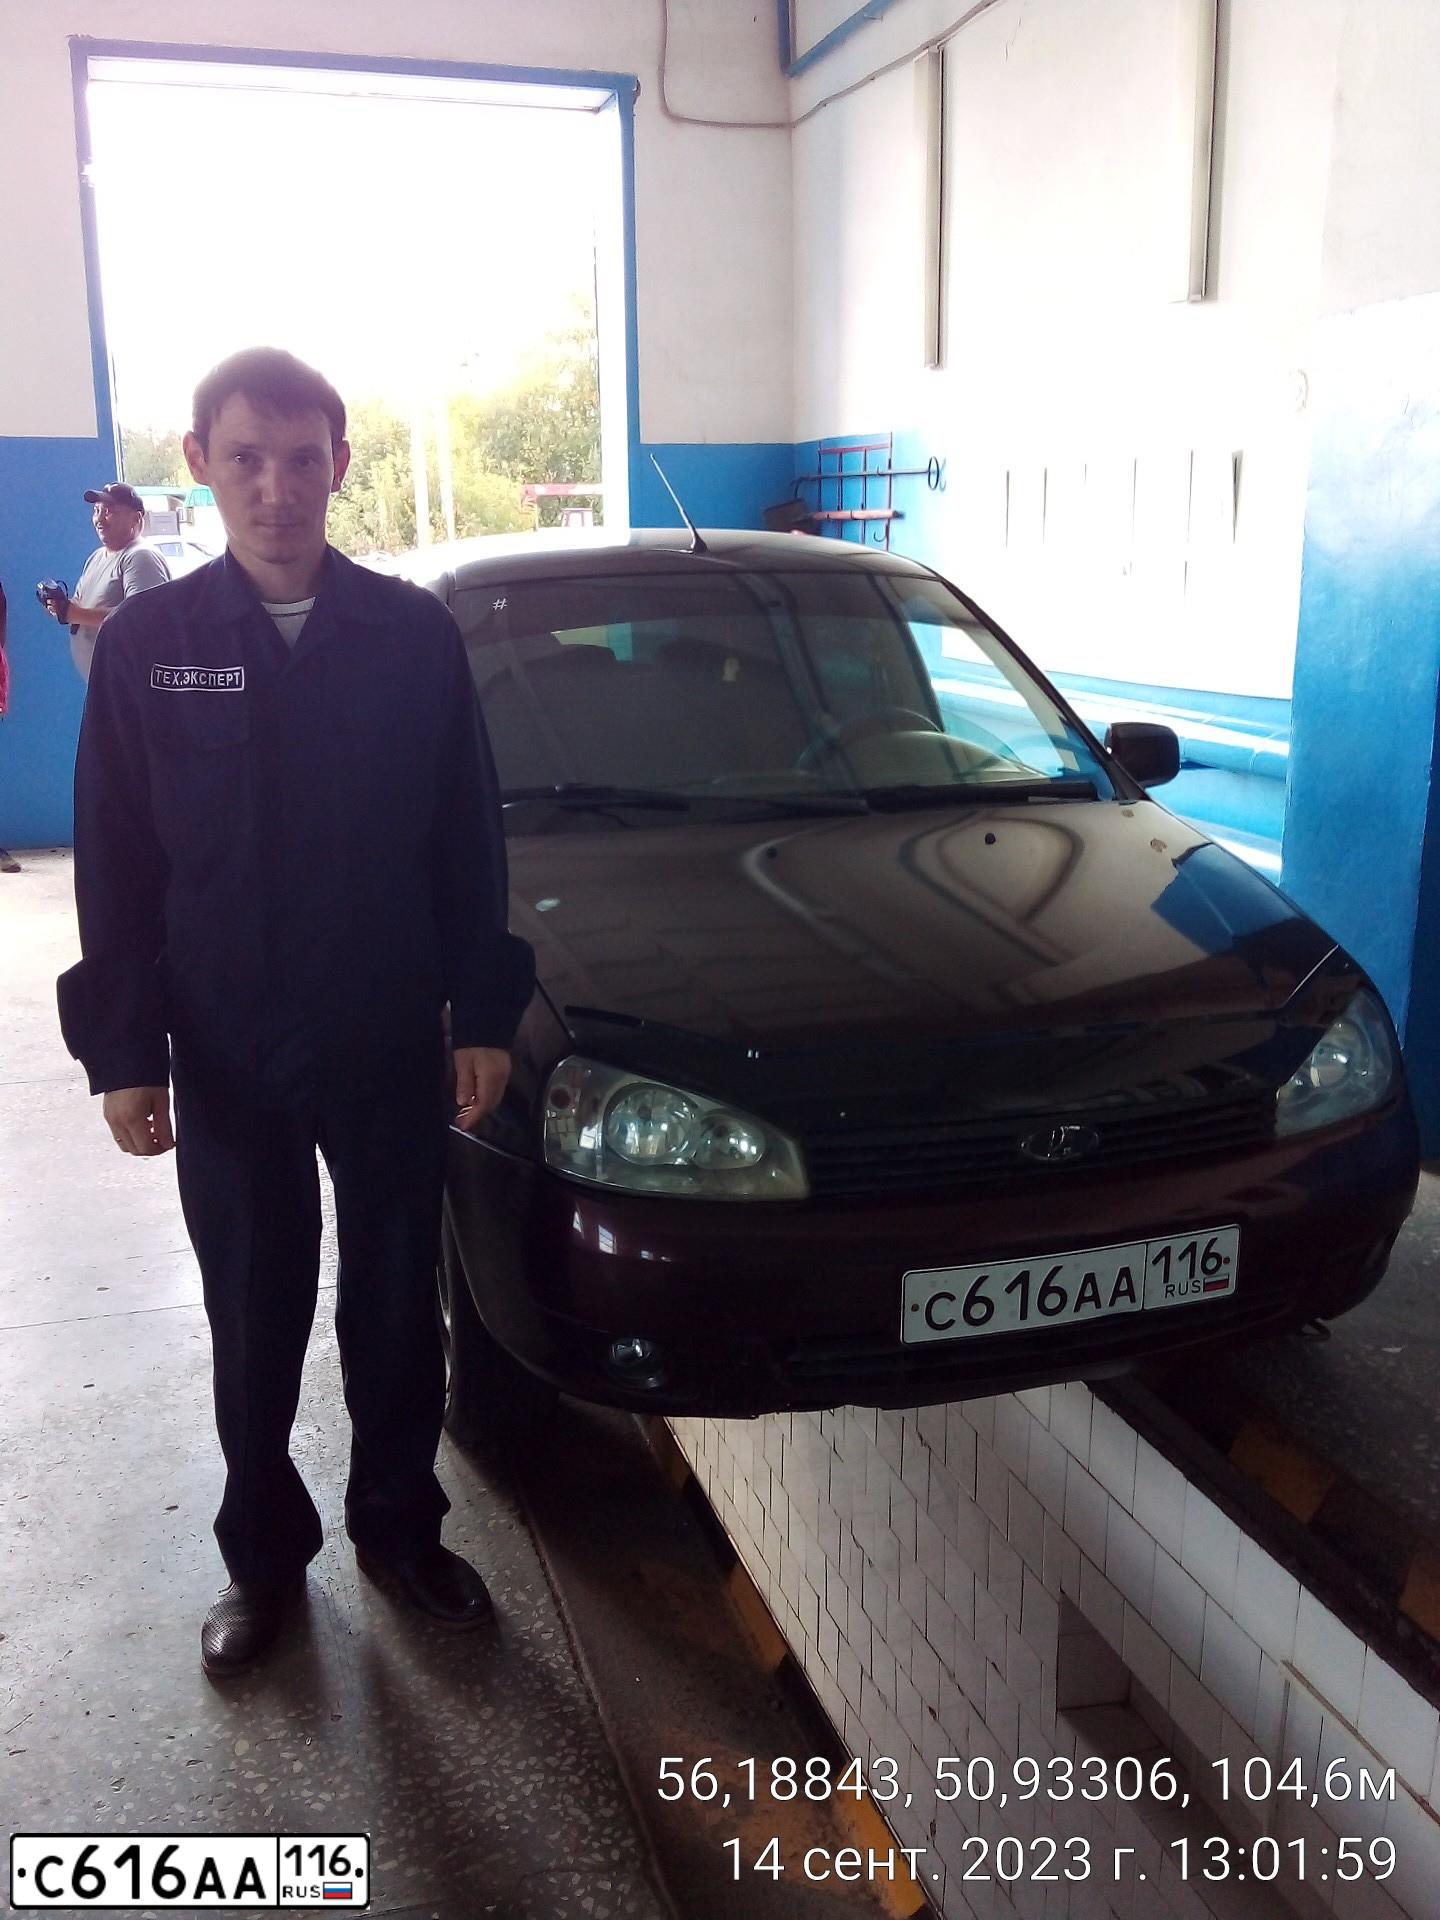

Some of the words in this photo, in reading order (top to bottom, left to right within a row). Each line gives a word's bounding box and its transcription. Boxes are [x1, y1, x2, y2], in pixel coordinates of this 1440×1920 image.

[924, 1264, 1138, 1332] С616АА
[1151, 1236, 1224, 1284] 116
[1163, 1279, 1202, 1299] RUS
